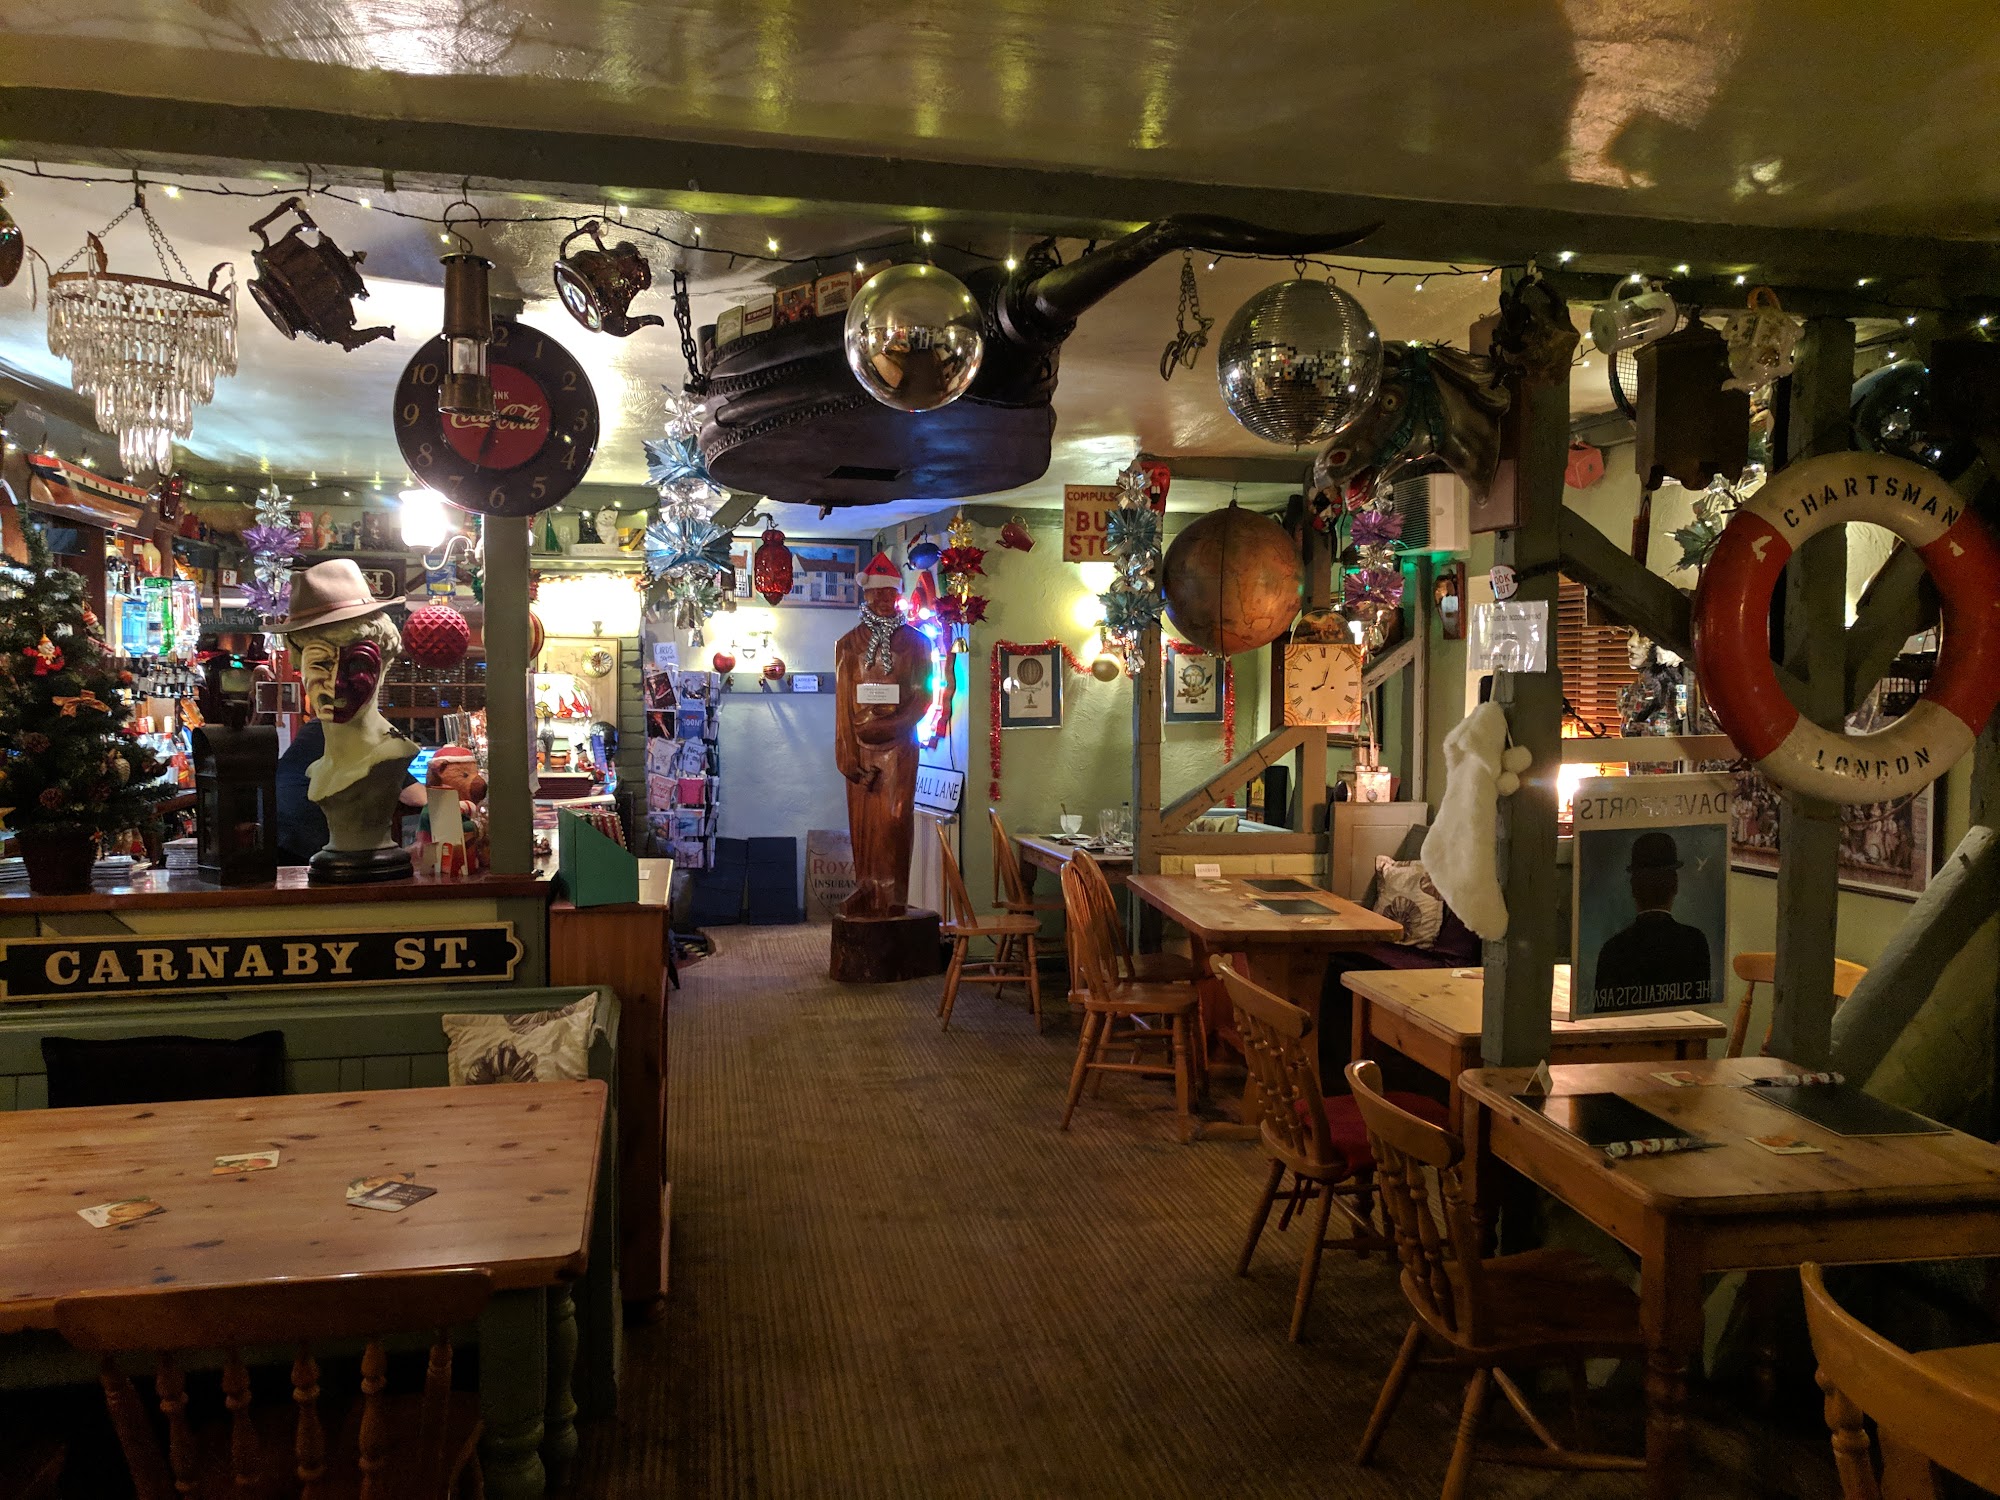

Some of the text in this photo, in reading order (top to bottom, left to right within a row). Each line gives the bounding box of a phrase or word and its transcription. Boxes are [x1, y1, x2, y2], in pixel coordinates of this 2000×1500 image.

[494, 326, 509, 347] 2
[410, 363, 438, 385] 10
[562, 371, 577, 391] 2
[402, 403, 420, 427] 9
[573, 408, 589, 432] 3
[416, 443, 433, 467] 8
[561, 445, 577, 470] 4
[489, 487, 506, 509] 6
[530, 476, 548, 499] 5
[1783, 475, 1959, 528] CHARTSMAN
[1076, 511, 1107, 532] BU
[1815, 747, 1931, 780] LONDON
[935, 779, 960, 801] LANE
[814, 879, 857, 888] INSURAN
[44, 937, 477, 985] CARNABY ST.
